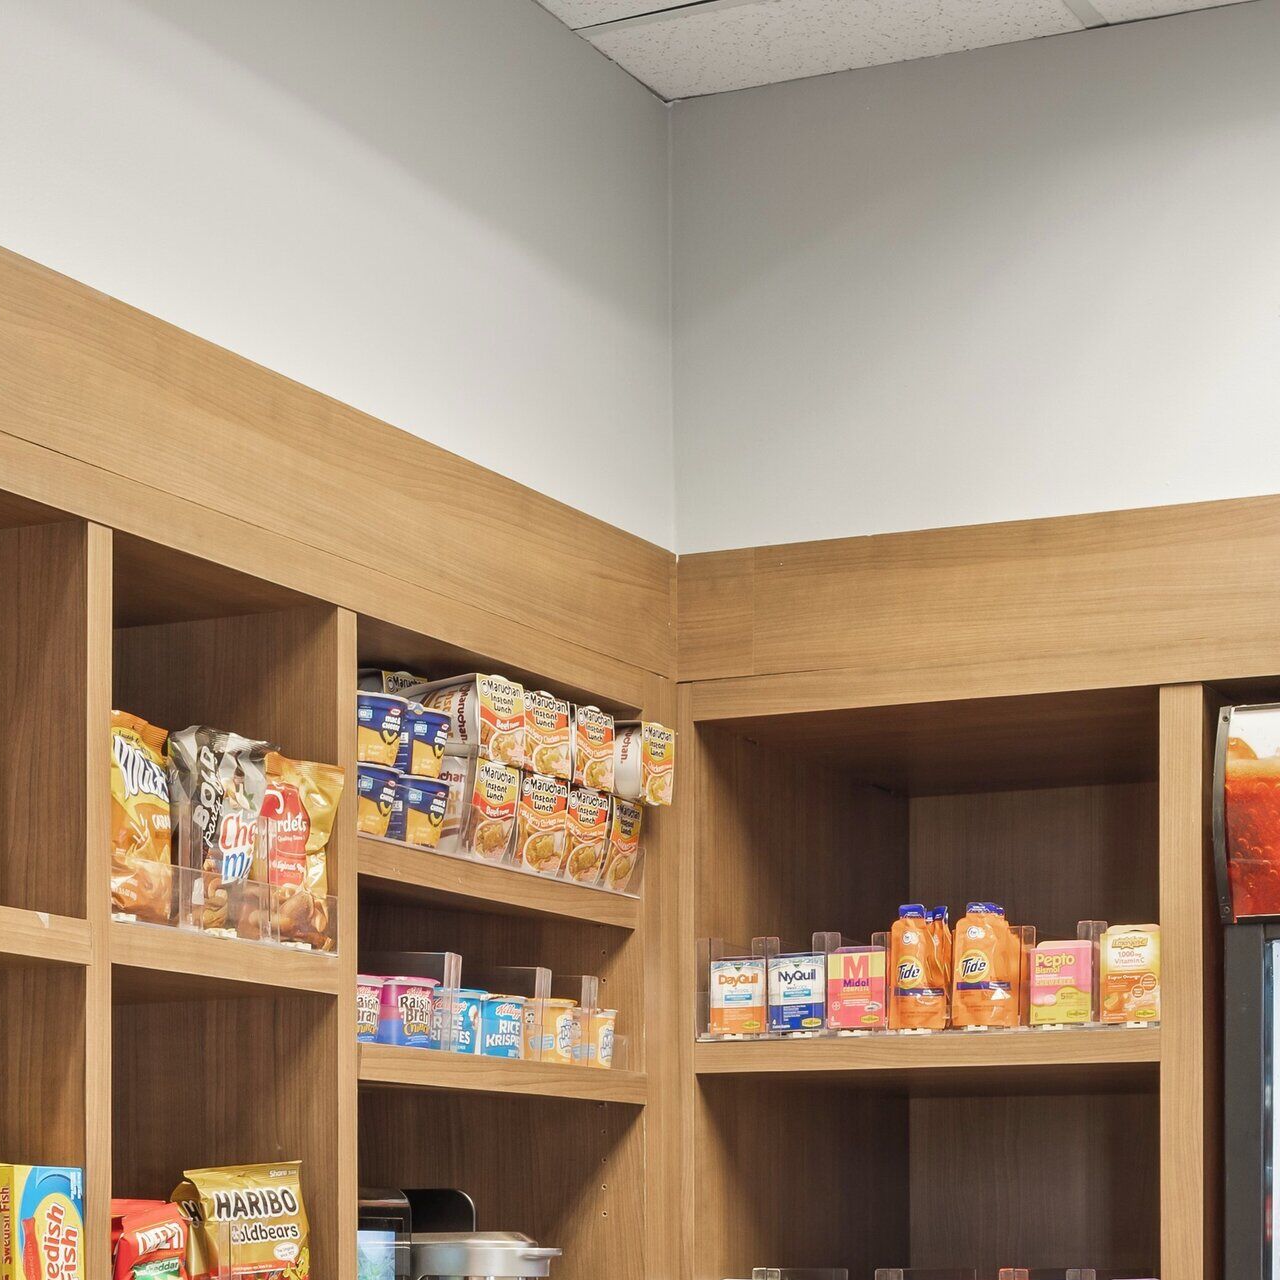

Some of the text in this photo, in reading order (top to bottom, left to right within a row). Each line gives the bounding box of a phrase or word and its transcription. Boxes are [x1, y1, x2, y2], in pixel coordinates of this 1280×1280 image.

[486, 679, 521, 698] Maruchan
[491, 693, 514, 706] Instant
[493, 703, 512, 714] Lunch
[844, 955, 869, 977] M
[962, 957, 987, 975] Tide
[1035, 953, 1075, 967] Pepto
[778, 969, 816, 984] NyQuil
[899, 963, 920, 980] Tide
[1035, 966, 1059, 974] Bismol
[718, 974, 758, 987] DayQuil
[843, 978, 869, 987] Midol
[0, 1186, 10, 1213] Fish
[215, 1189, 297, 1218] HARIBO
[232, 1224, 298, 1244] Goldbears
